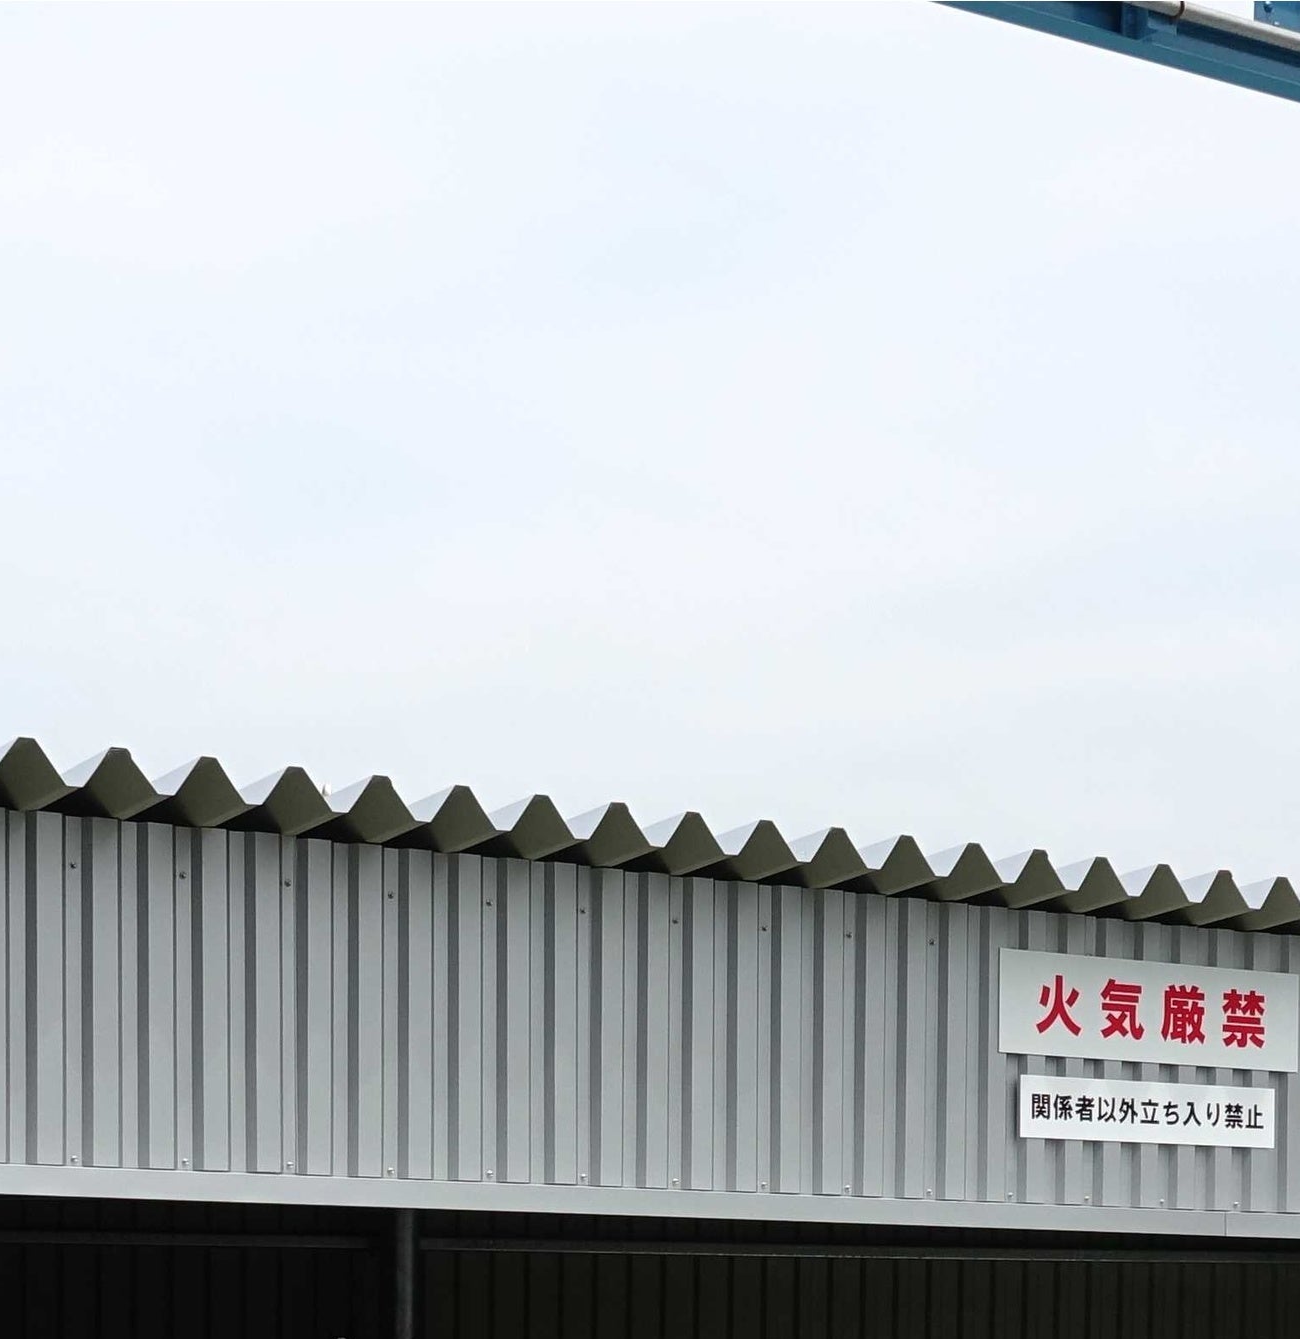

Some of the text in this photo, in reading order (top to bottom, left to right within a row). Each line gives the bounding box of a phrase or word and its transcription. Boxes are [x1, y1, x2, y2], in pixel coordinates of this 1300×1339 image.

[1036, 975, 1265, 1049] 火気厳禁
[1031, 1093, 1264, 1129] 関係者以外立ち入り禁止
